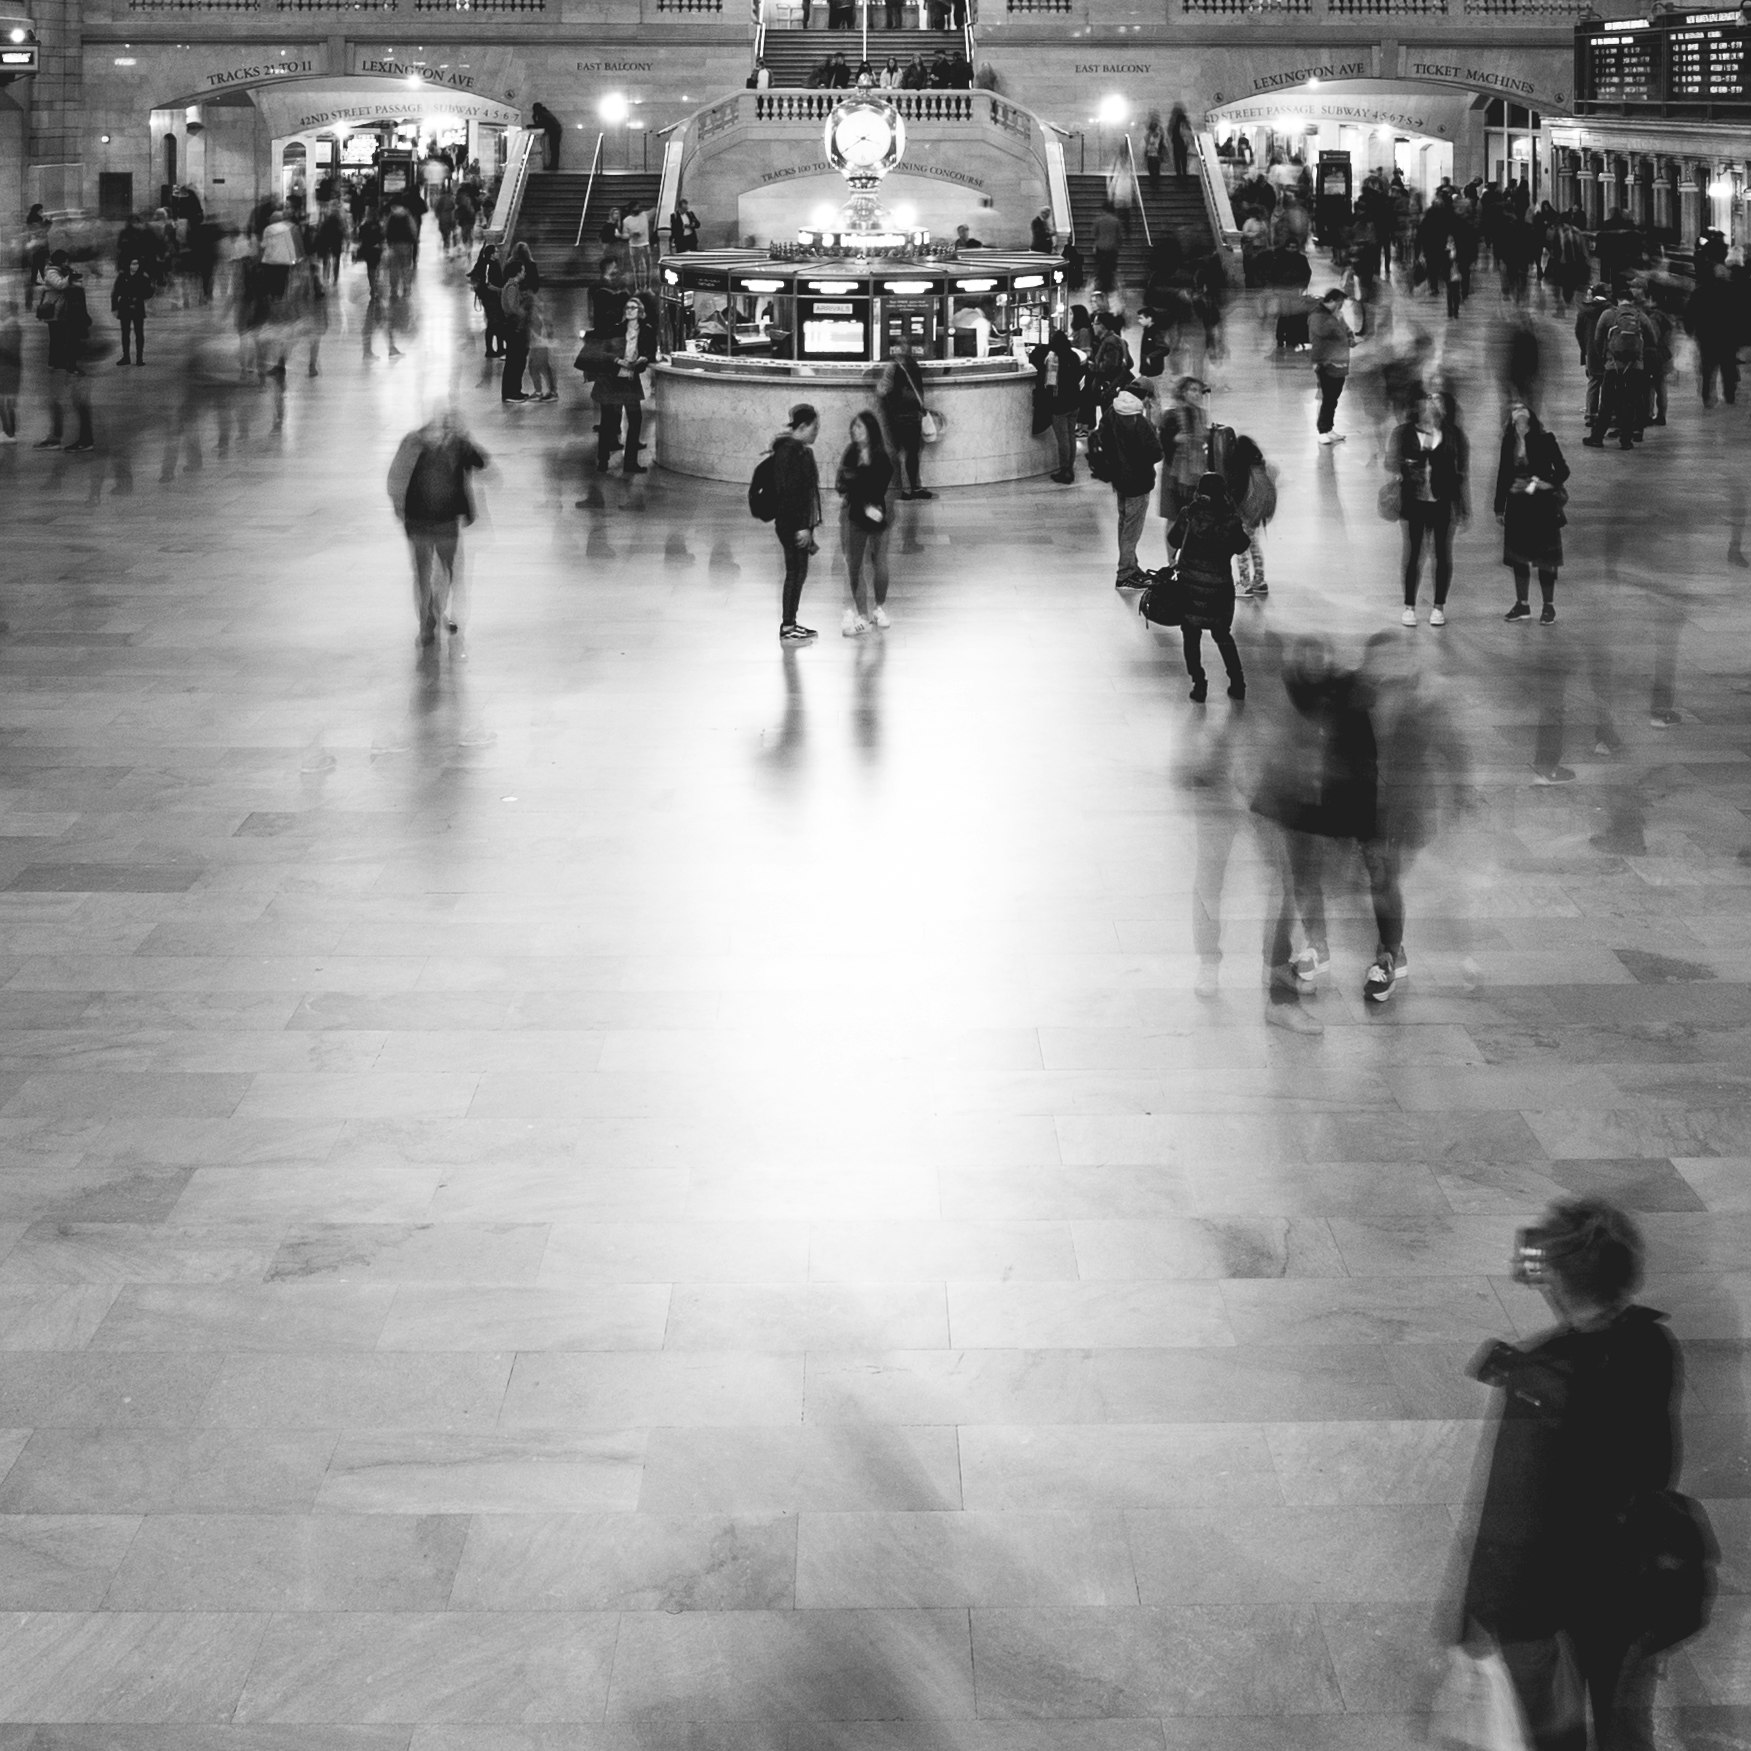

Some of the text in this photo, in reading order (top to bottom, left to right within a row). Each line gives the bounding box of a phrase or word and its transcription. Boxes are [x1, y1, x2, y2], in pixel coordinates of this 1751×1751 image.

[207, 66, 260, 85] TRACKS
[279, 61, 298, 74] TO
[302, 61, 312, 71] 11
[362, 60, 474, 88] LEXINGTON AVE
[577, 62, 653, 71] EAST BALCONY
[1075, 64, 1151, 73] EAST BALCONY
[1252, 62, 1366, 91] LEXINGTON AVE
[1413, 62, 1536, 95] TICKET MACHINES
[299, 114, 329, 126] 42ND
[331, 106, 372, 120] STREET
[375, 104, 423, 114] PASSAGE
[433, 104, 481, 116] SUBWAY
[1221, 107, 1265, 120] STREET
[1320, 107, 1370, 118] SUBWAY
[761, 166, 797, 183] TRACKS
[812, 162, 826, 171] TO
[929, 166, 985, 188] CONCOURSE
